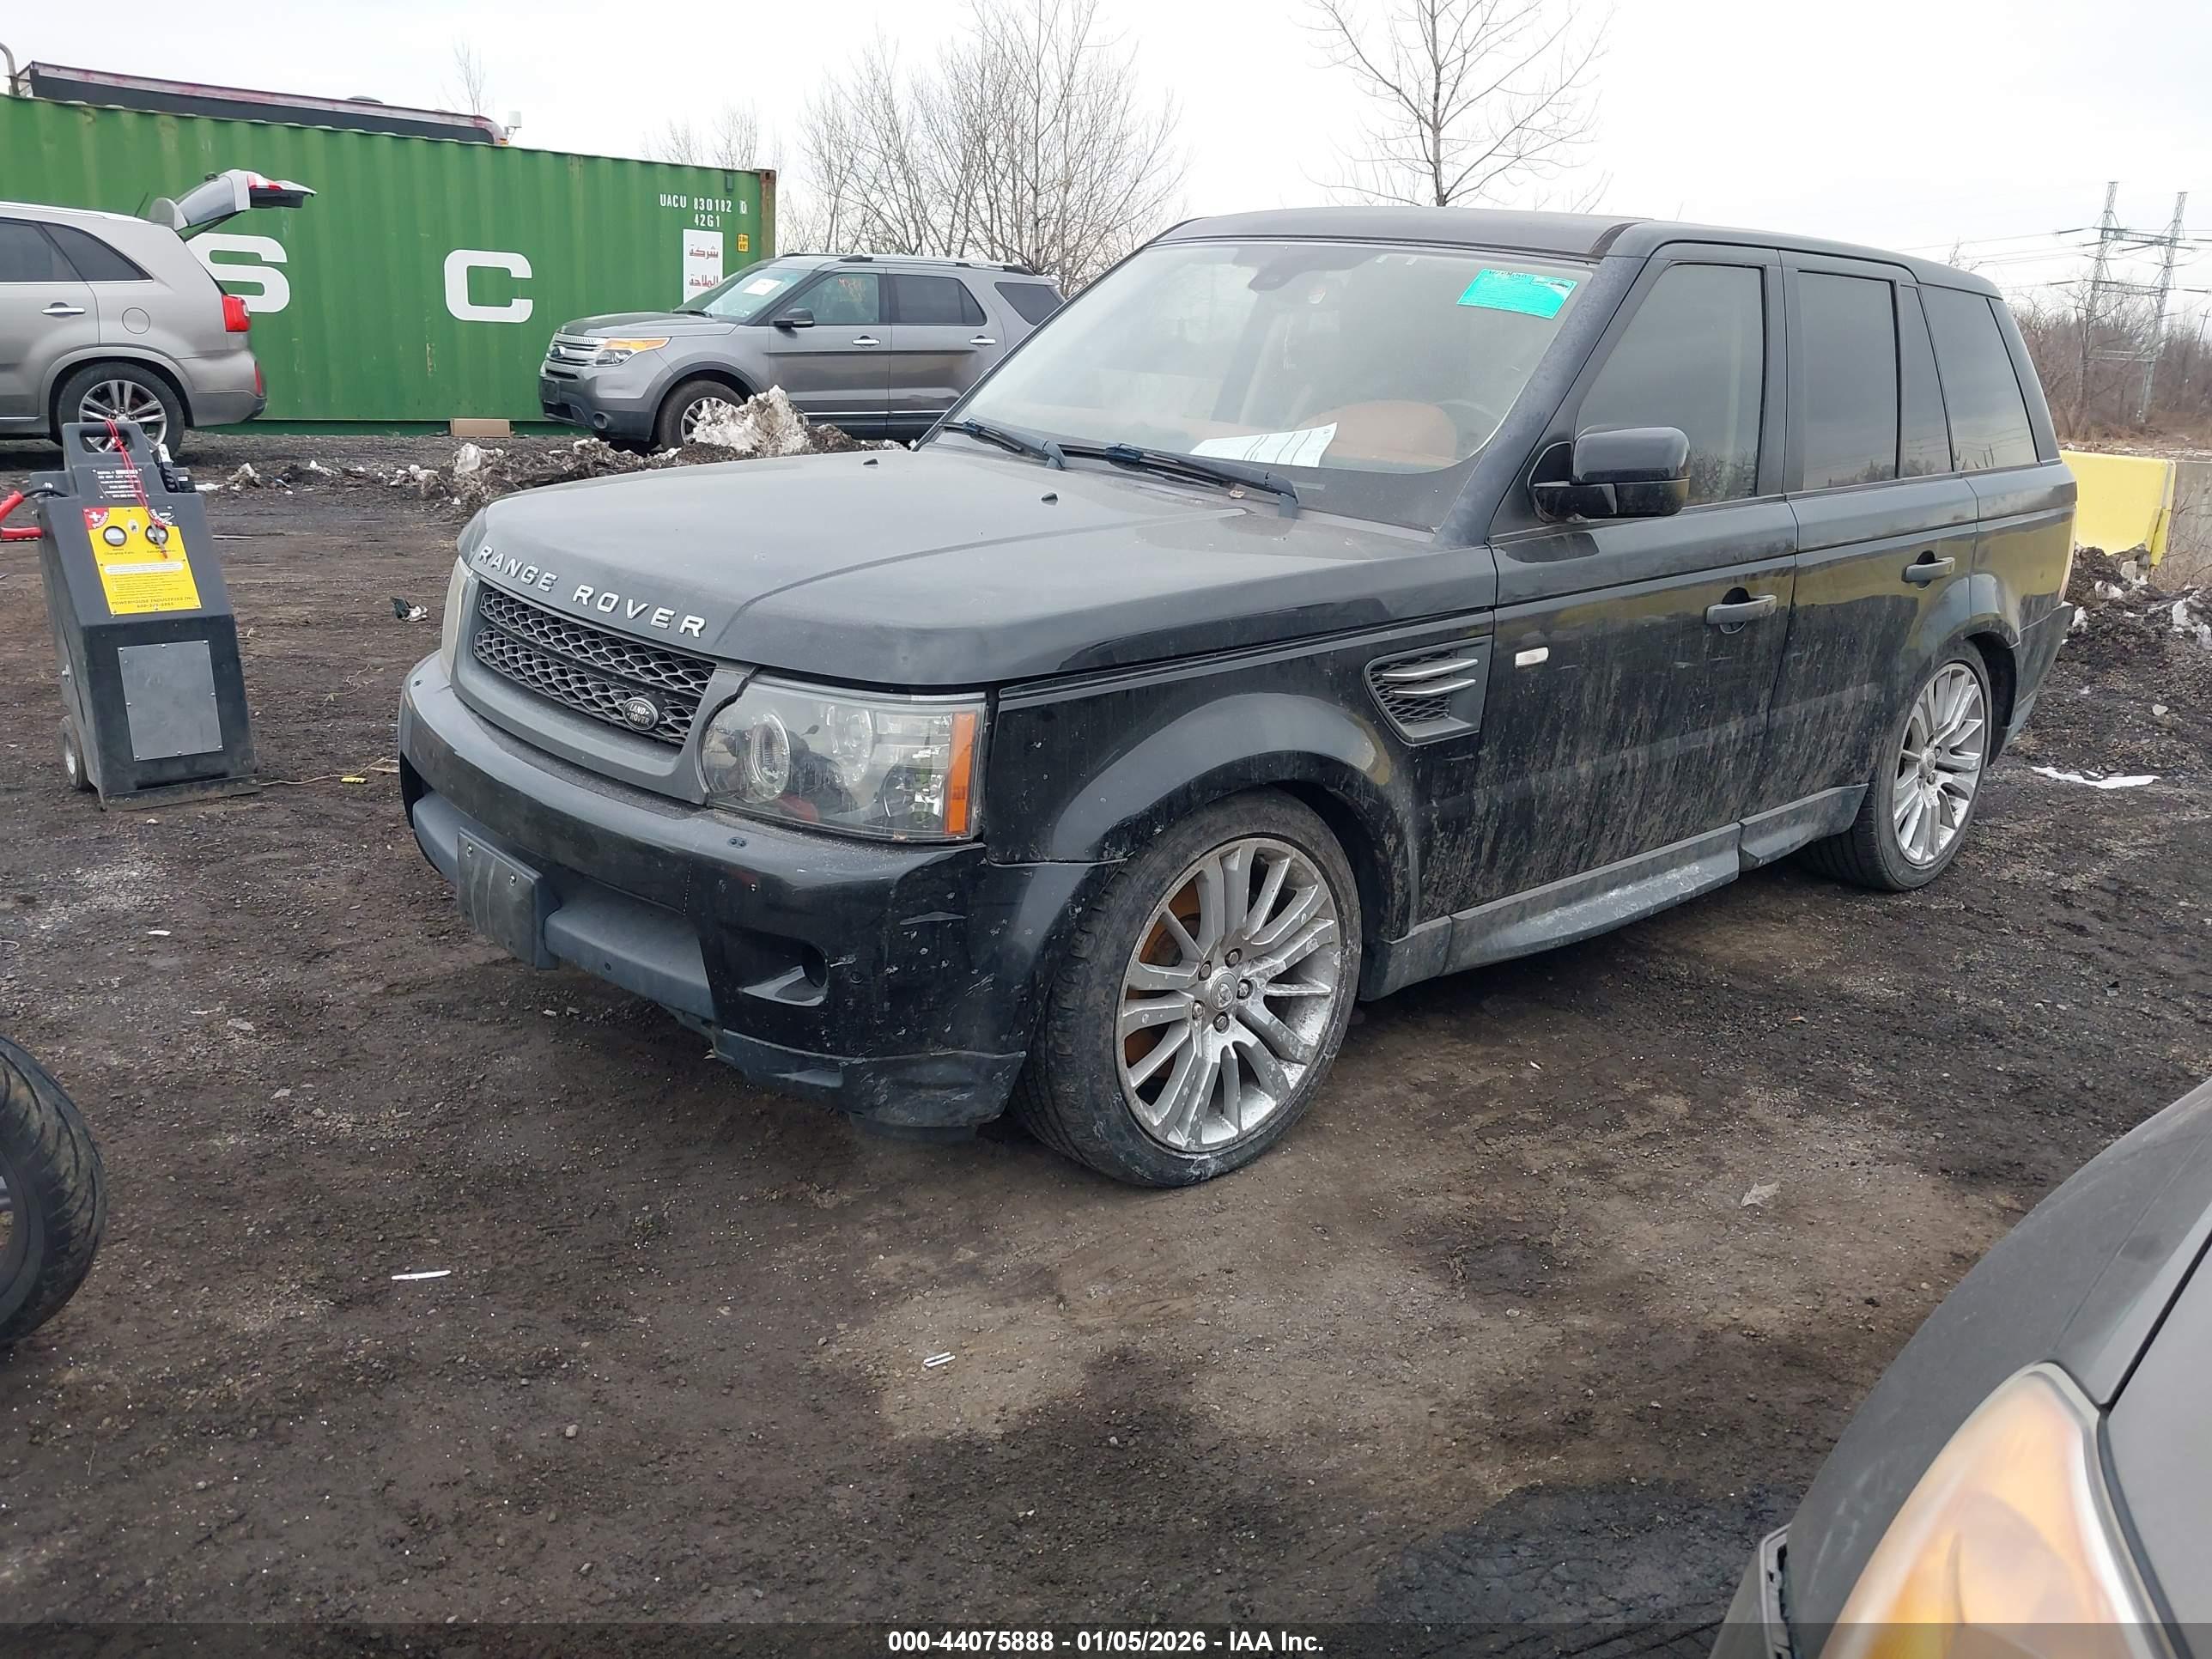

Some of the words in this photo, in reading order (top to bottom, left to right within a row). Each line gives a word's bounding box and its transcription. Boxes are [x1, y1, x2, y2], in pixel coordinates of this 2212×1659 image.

[659, 193, 687, 208] UACU
[693, 197, 732, 213] 830182
[694, 213, 720, 228] 42G1
[185, 233, 290, 313] S
[444, 249, 533, 324] C
[478, 544, 558, 592] RANGE
[572, 584, 708, 638] ROVER
[629, 703, 647, 715] LAND
[629, 712, 650, 728] ROVER
